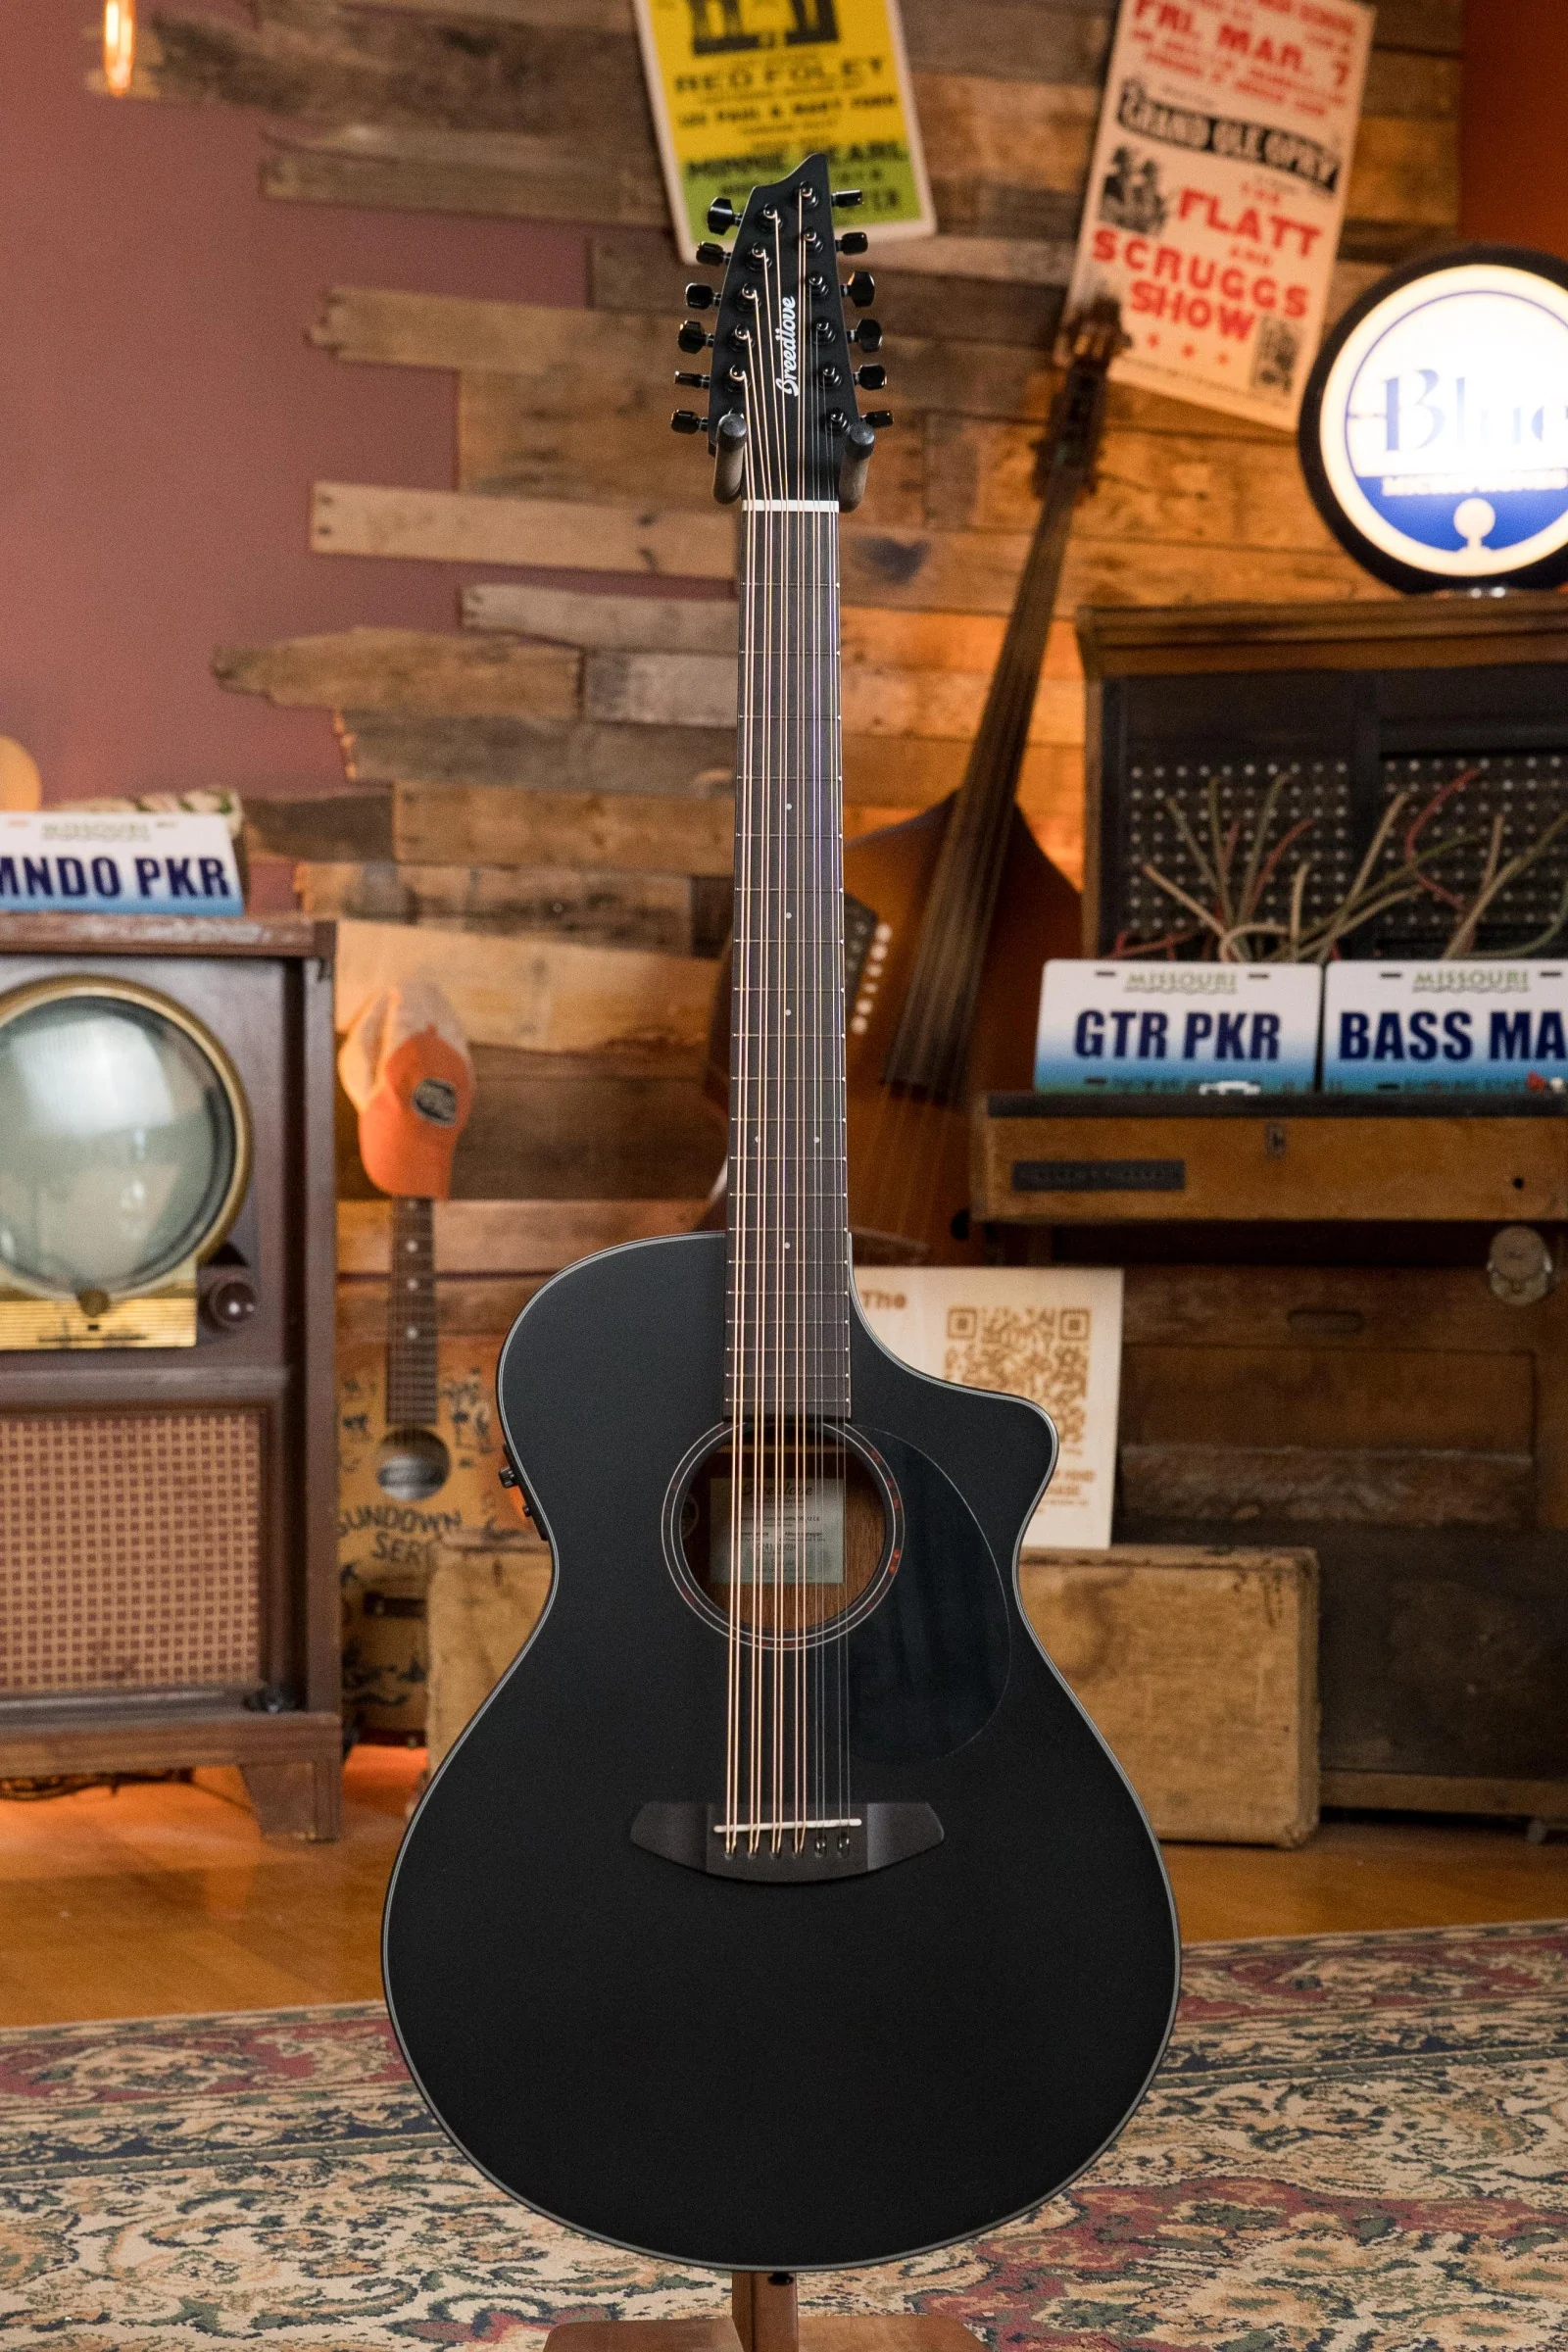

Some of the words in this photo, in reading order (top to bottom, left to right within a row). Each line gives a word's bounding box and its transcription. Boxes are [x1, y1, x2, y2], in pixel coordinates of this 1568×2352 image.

[1178, 187, 1321, 259] FLATT
[1093, 228, 1308, 318] SCRUGGS
[1130, 280, 1255, 341] SHOW
[775, 296, 799, 397] Breedlove
[134, 857, 231, 898] PKR
[1124, 971, 1238, 995] MISSOURI
[1412, 969, 1531, 994] MISSOURI
[1074, 1009, 1169, 1059] GTR
[1183, 1012, 1282, 1061] PKR
[1340, 1011, 1473, 1061] BASS
[1490, 1011, 1567, 1061] MA
[861, 1289, 907, 1309] The
